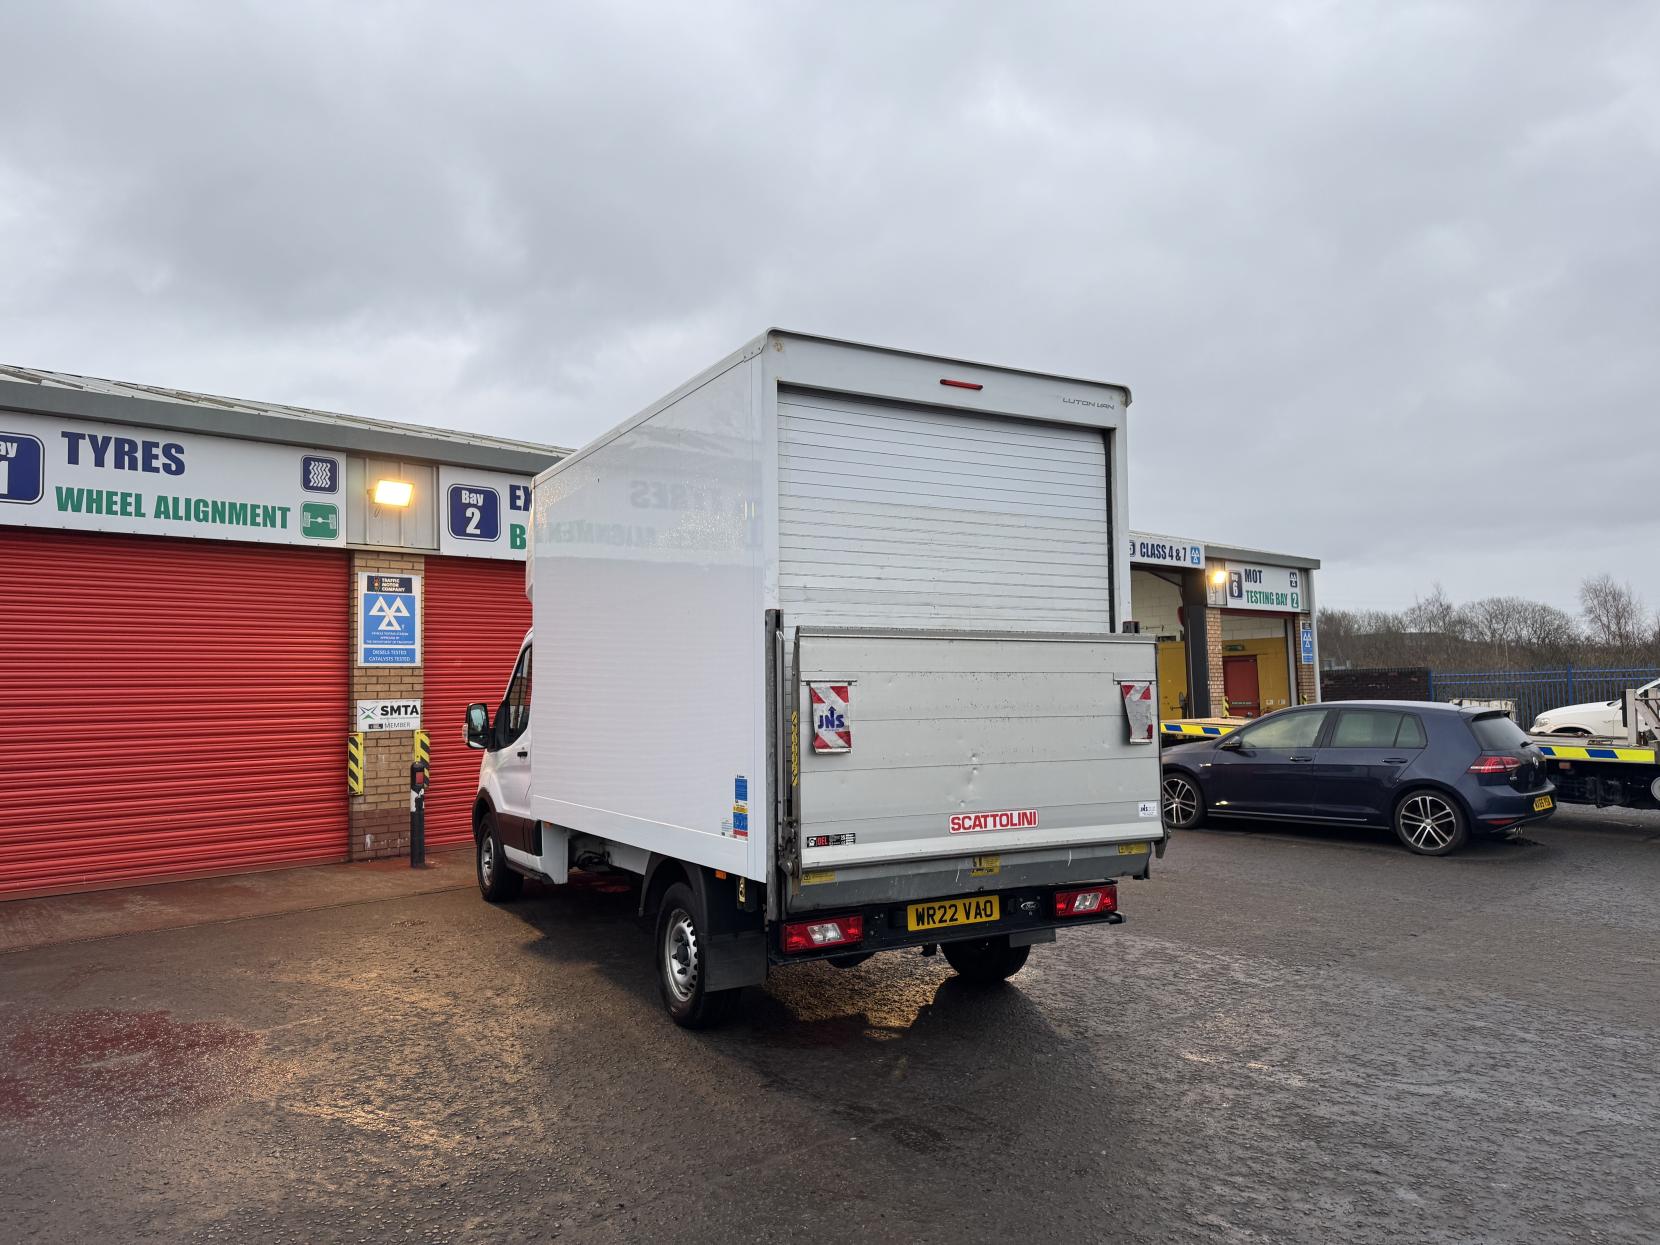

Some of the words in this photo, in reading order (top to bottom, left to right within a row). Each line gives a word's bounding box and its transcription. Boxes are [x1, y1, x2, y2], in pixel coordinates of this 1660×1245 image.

[1062, 397, 1096, 407] LUTON
[0, 440, 18, 458] ay
[61, 431, 186, 476] TYRES
[55, 485, 147, 518] WHEEL
[153, 495, 291, 529] ALIGNMENT
[461, 489, 484, 507] Bay
[465, 507, 481, 535] 2
[1139, 542, 1167, 560] CLASS
[1168, 545, 1174, 561] 4
[1175, 548, 1181, 562] &
[1182, 547, 1187, 562] 7
[1244, 568, 1263, 584] MOT
[1232, 581, 1239, 597] 6
[1245, 590, 1274, 606] TESTING
[1275, 592, 1288, 606] BAY
[1292, 593, 1299, 608] 2
[380, 704, 420, 716] SMTA
[817, 713, 845, 729] JNS
[951, 811, 1037, 832] SCATTOLINI
[915, 904, 959, 927] WR22
[962, 899, 994, 921] VAO
